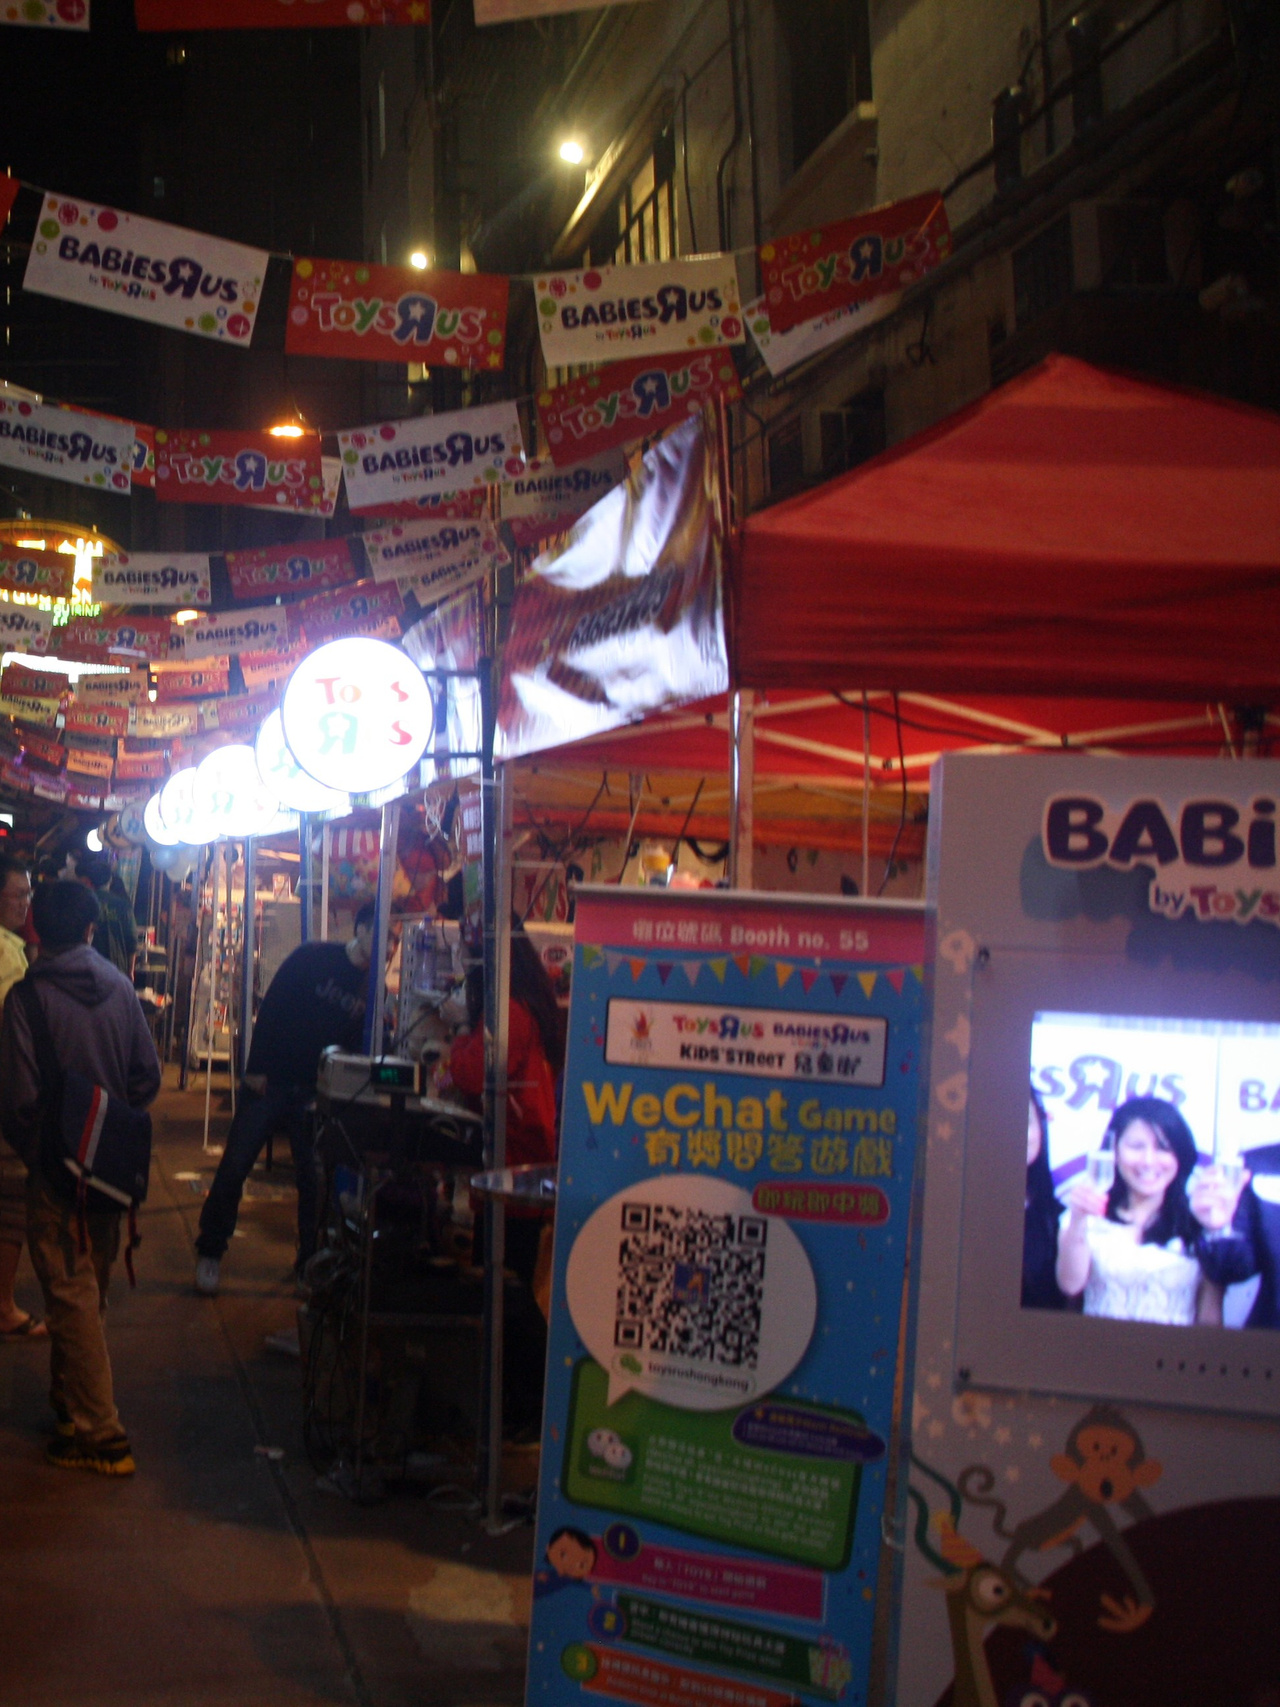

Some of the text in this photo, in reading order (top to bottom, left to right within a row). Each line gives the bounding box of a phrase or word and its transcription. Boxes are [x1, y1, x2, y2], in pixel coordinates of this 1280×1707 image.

[1153, 885, 1184, 911] by
[730, 923, 790, 948] Booth
[798, 931, 830, 951] no.
[582, 1081, 897, 1135] WeChat Game
